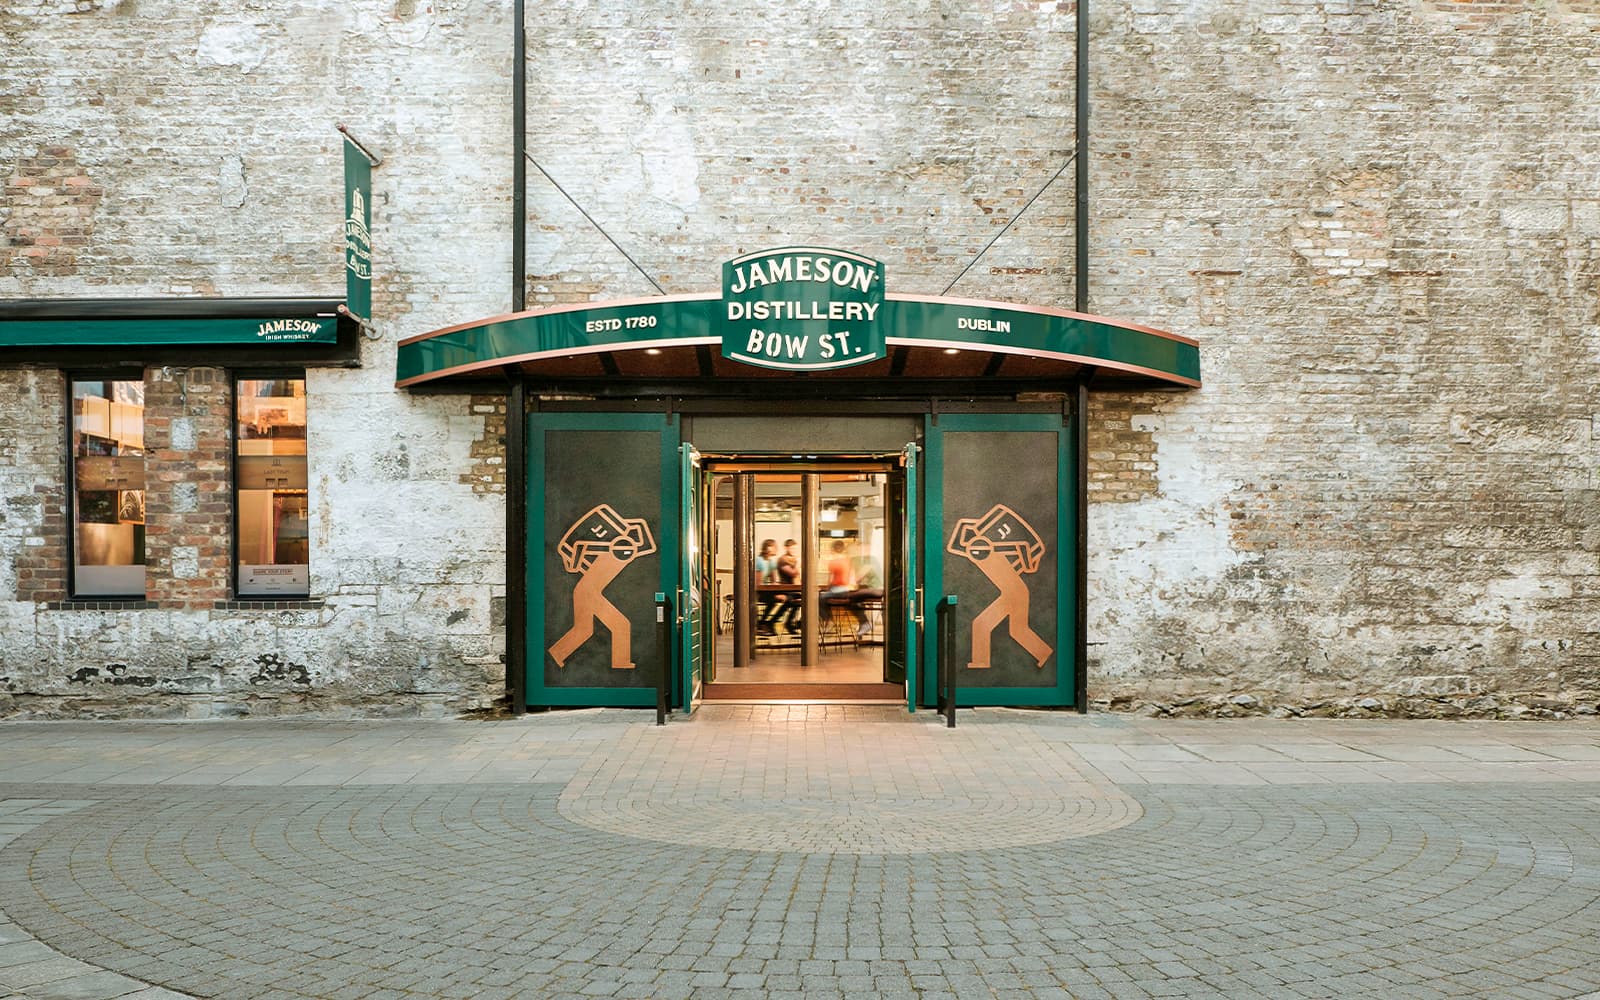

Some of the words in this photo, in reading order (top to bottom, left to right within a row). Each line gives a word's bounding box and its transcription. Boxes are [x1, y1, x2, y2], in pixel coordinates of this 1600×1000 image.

[731, 257, 876, 293] JAMESON
[728, 301, 879, 320] DISTILLERY
[257, 319, 320, 336] JAMESON
[586, 318, 622, 332] ESTD
[625, 316, 657, 328] 1780
[958, 317, 1010, 333] DUBLIN
[746, 328, 808, 358] BOW
[818, 331, 861, 358] ST.
